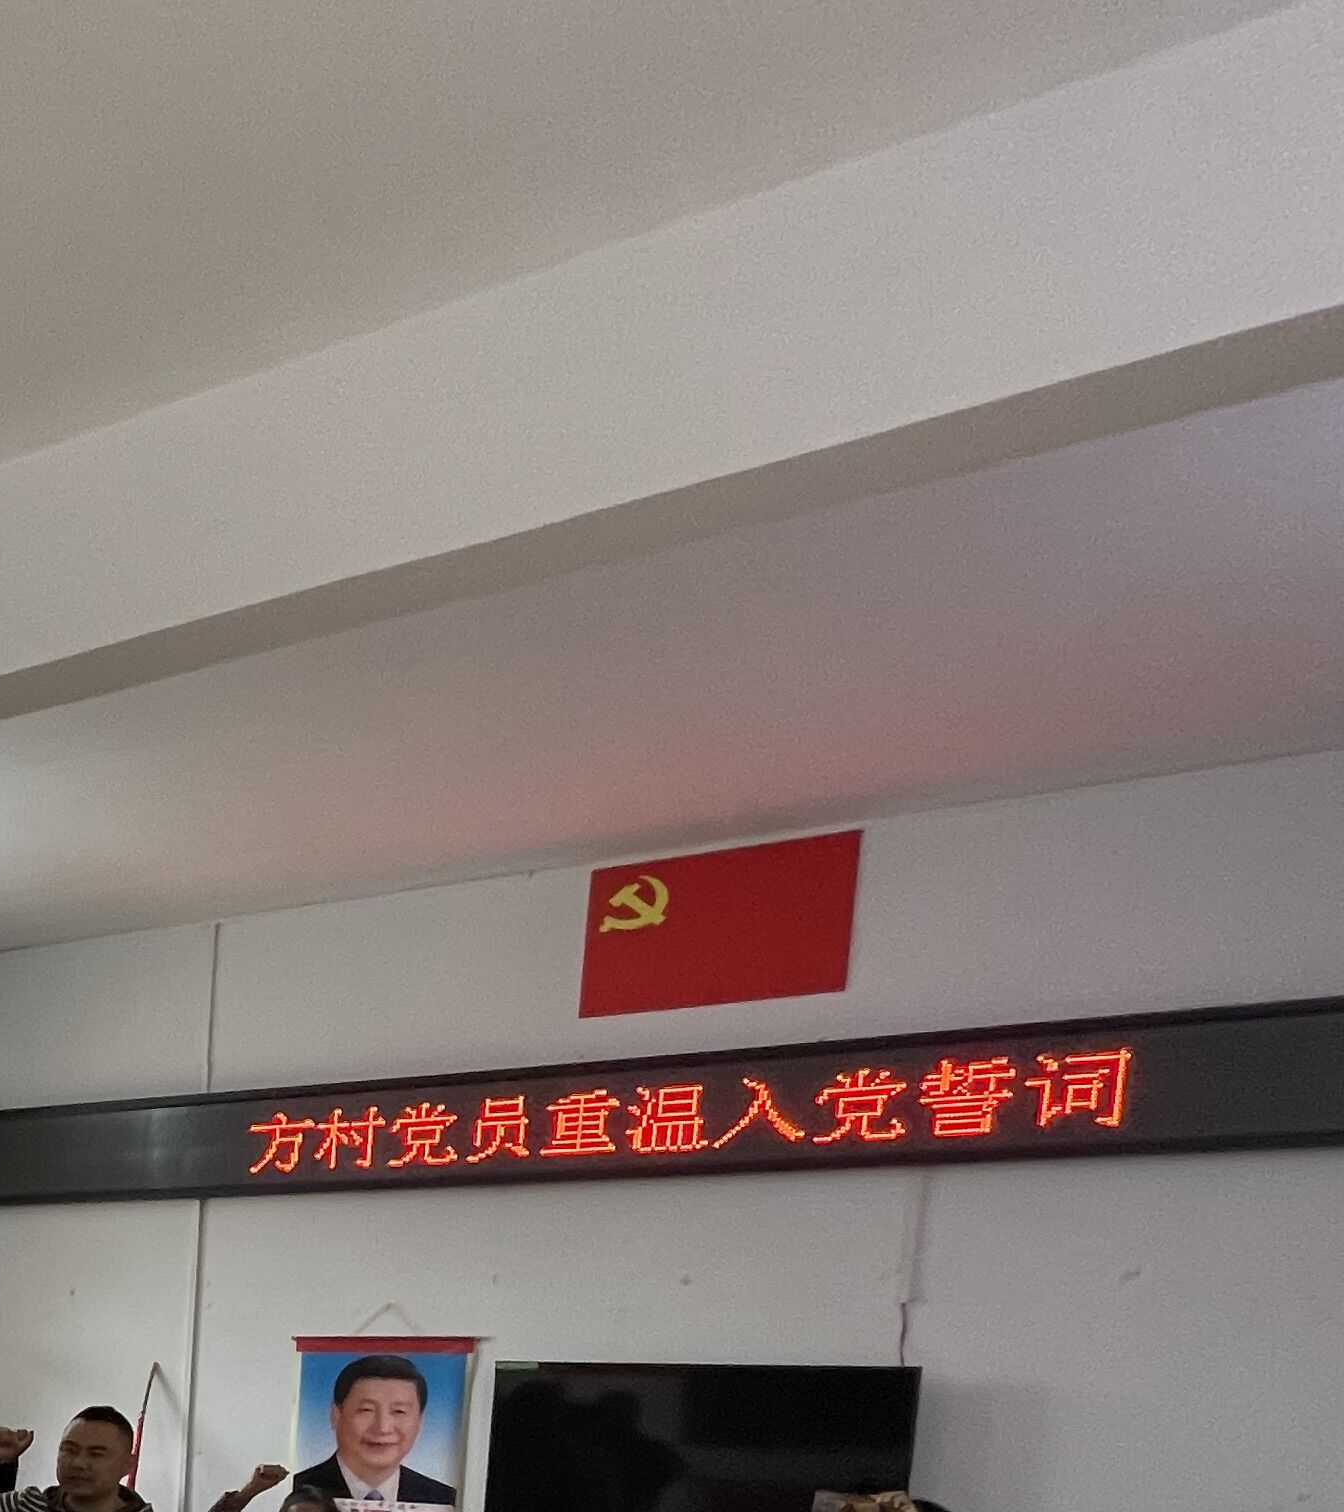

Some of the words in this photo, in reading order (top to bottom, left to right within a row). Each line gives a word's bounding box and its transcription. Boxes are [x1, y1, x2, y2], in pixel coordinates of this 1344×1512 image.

[248, 1046, 1133, 1175] 方村党员重温入党誓词
